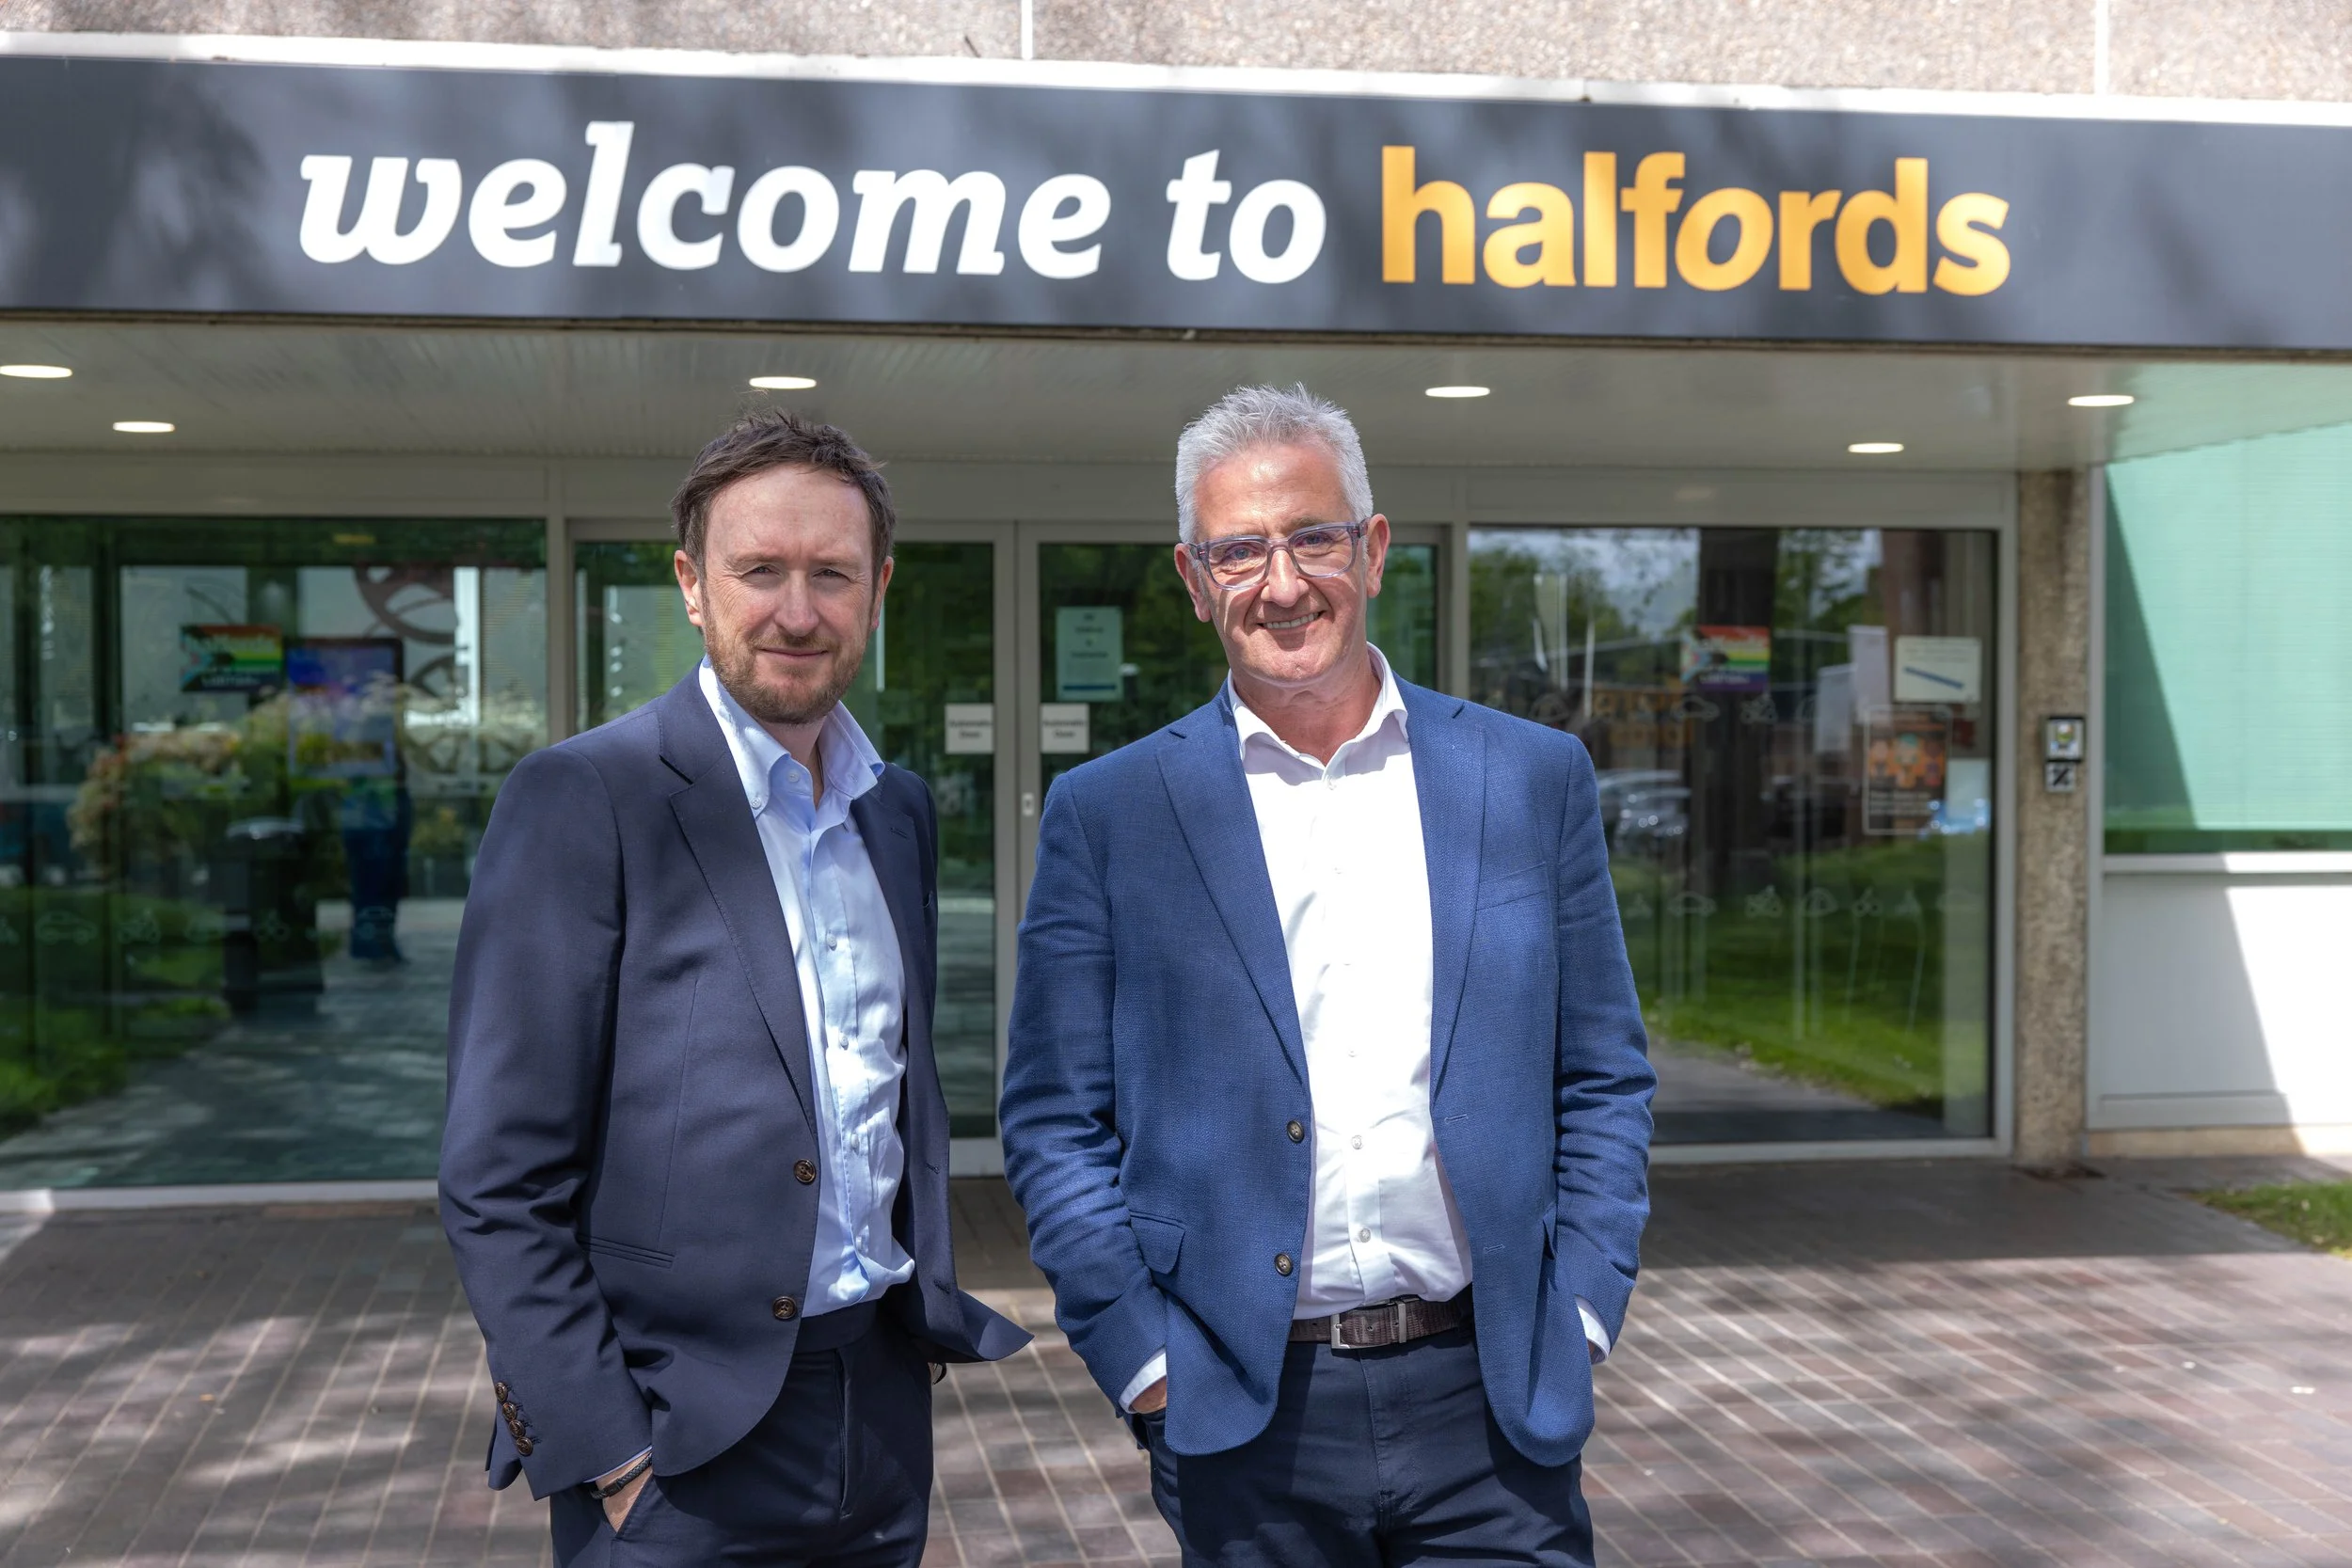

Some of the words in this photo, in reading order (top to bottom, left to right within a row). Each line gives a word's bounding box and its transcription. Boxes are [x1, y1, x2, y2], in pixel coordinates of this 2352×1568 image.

[298, 120, 1112, 280] welcome
[1165, 148, 1327, 285] to
[1381, 145, 2011, 297] halfords
